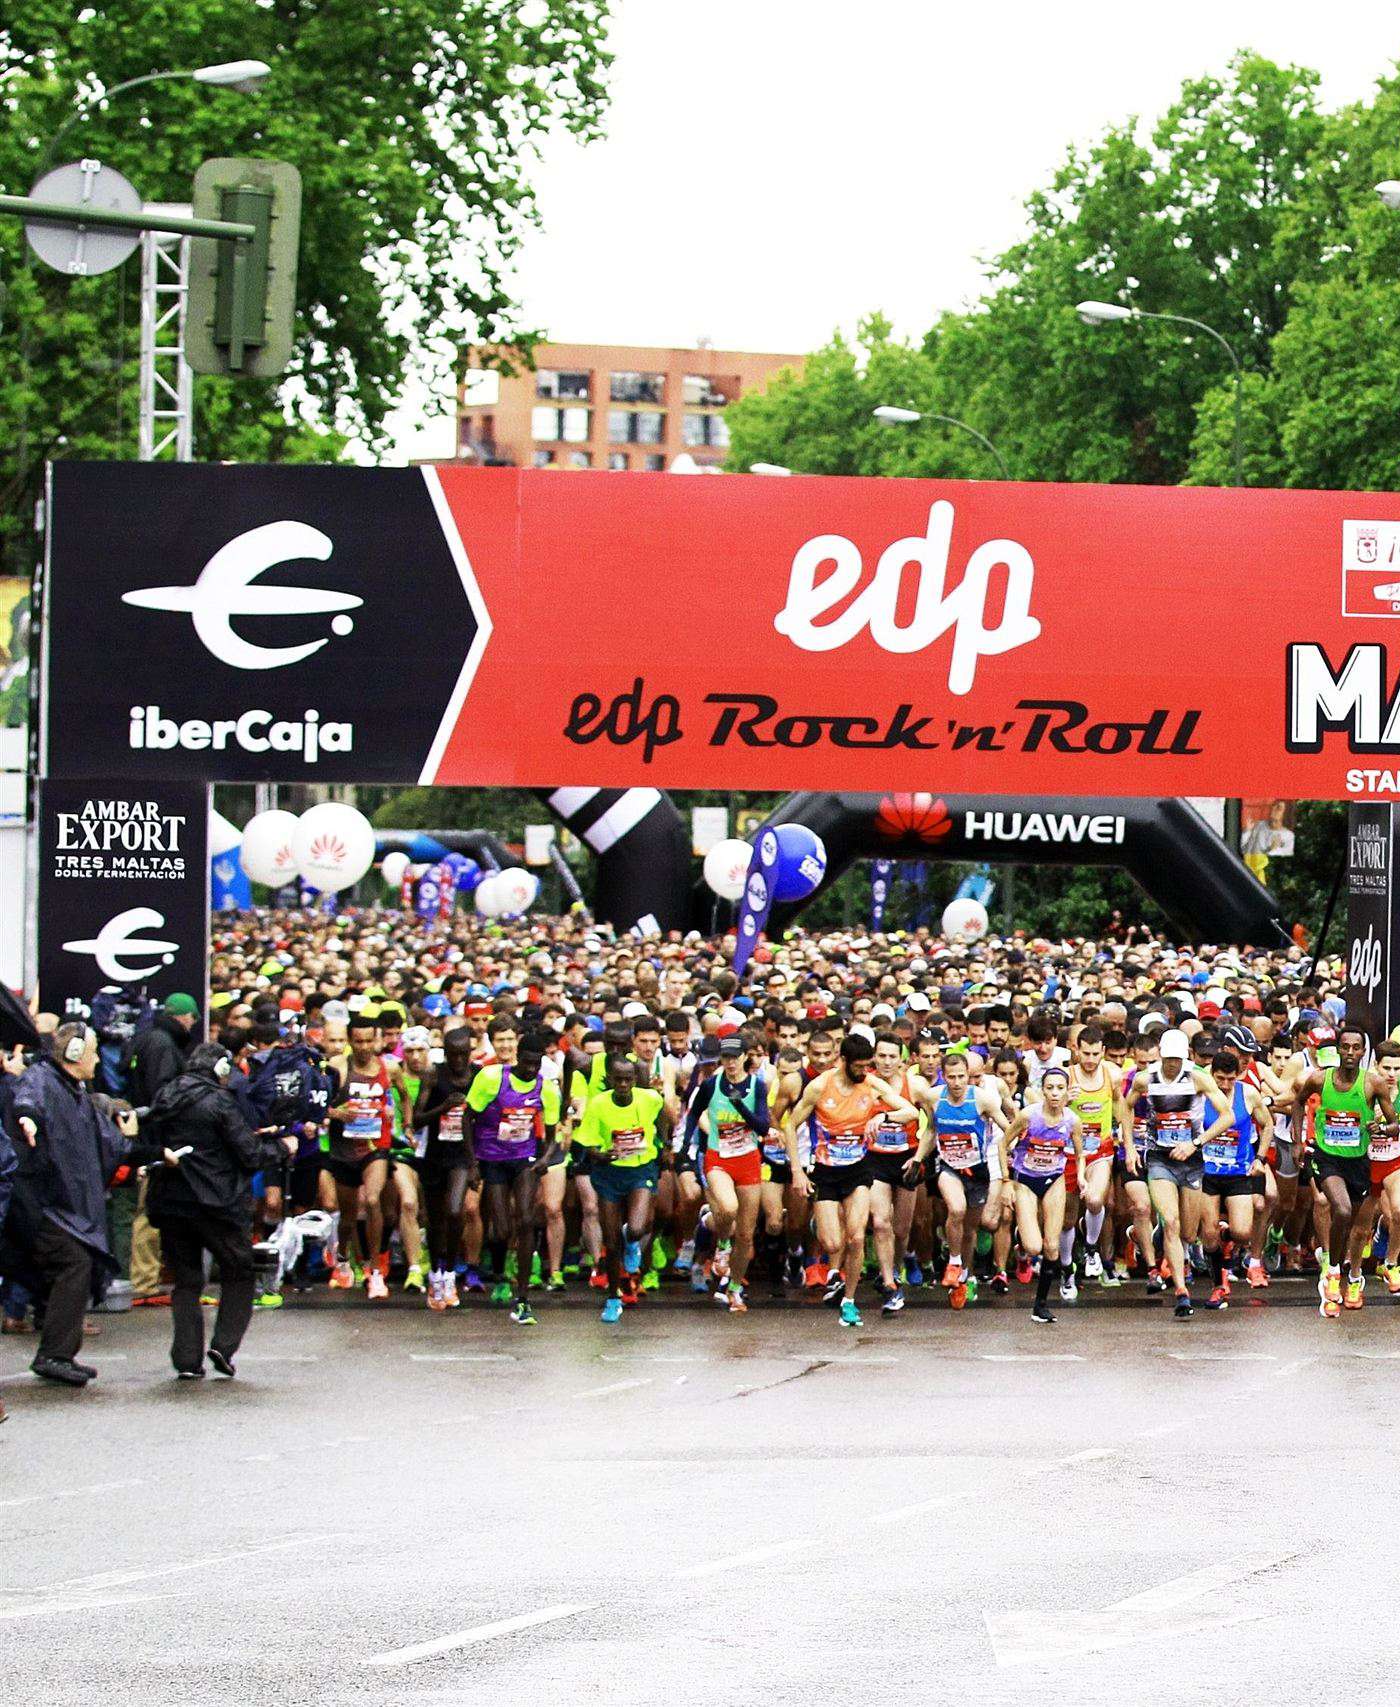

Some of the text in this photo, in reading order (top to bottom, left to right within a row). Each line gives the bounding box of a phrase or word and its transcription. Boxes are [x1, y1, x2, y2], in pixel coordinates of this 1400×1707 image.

[774, 500, 1042, 696] edp
[129, 706, 354, 763] iberCaja
[565, 678, 684, 764] edp
[81, 801, 161, 821] AMBAR
[966, 812, 1126, 844] HUAWEI
[56, 813, 186, 851] EXPORT
[55, 856, 186, 871] TRES MALTAS
[1350, 835, 1387, 869] EXPORT
[55, 870, 186, 880] DOBLE FERMENTACIÓN
[1350, 923, 1382, 1004] edp
